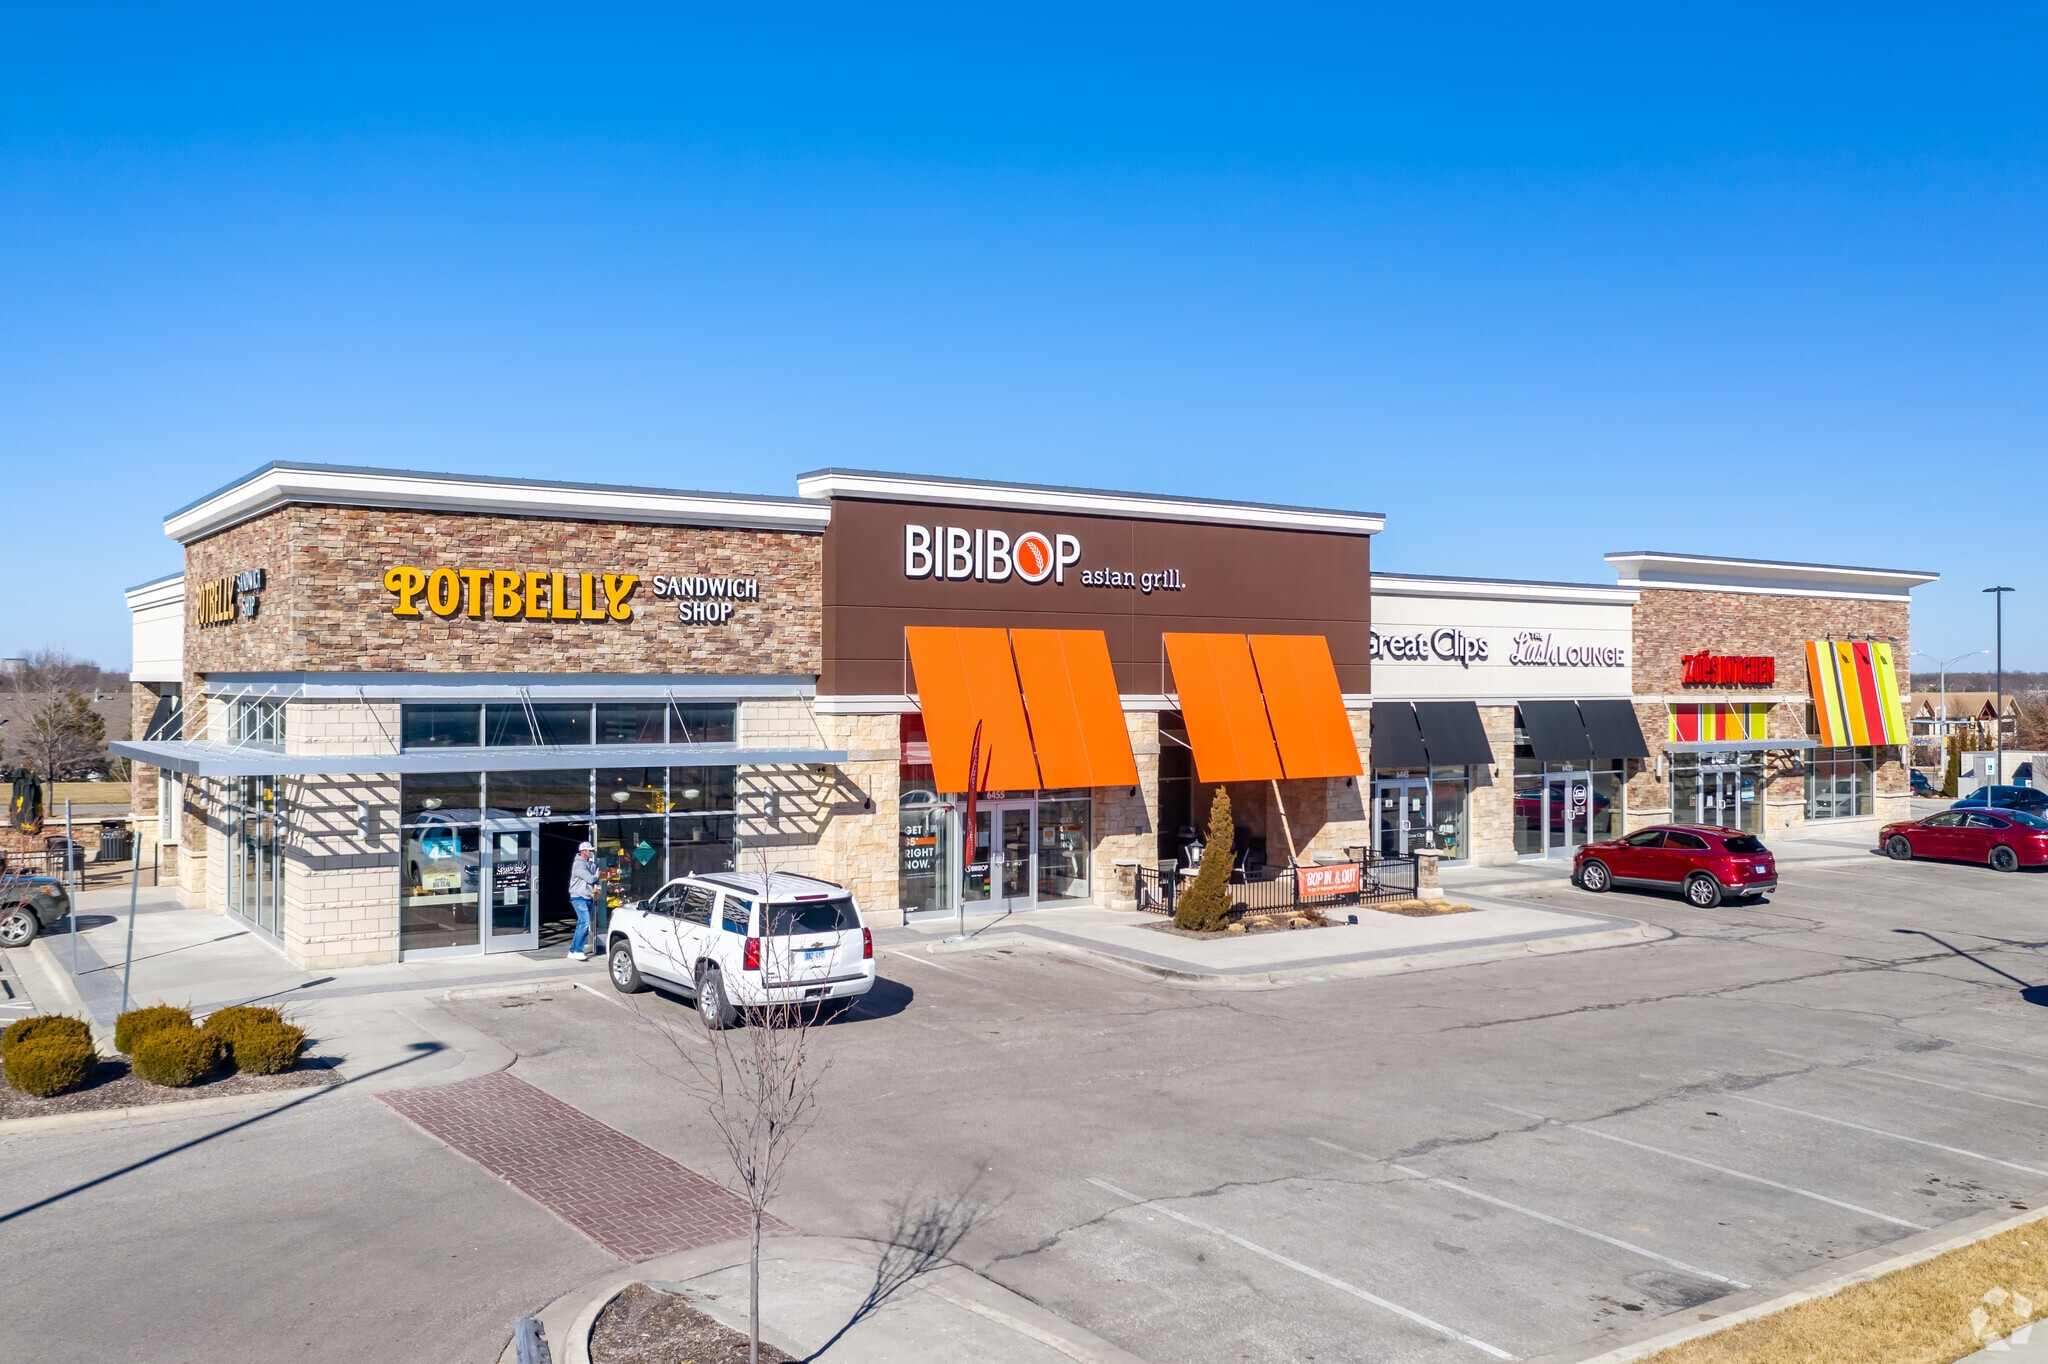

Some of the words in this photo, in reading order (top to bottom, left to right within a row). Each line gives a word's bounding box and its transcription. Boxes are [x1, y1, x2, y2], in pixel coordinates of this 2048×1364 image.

[905, 524, 1081, 583] BIBIBOP
[1081, 567, 1136, 588] asian
[1140, 568, 1187, 593] grill.
[384, 566, 640, 621] POTBELLY
[652, 575, 758, 599] SANDWICH
[194, 575, 235, 625] POTBELLY
[679, 601, 734, 623] SHOP
[1370, 625, 1429, 660] Great
[1431, 628, 1489, 666] Clips
[1509, 631, 1558, 665] Lash
[1556, 647, 1625, 667] LOUNGE
[1719, 656, 1775, 684] KITCHEN
[987, 790, 1005, 800] 6455
[527, 805, 551, 817] 6475
[905, 825, 923, 835] GET
[905, 847, 934, 858] RIGHT
[905, 859, 931, 869] NOW.
[1335, 871, 1341, 884] &
[1341, 868, 1356, 883] OUT
